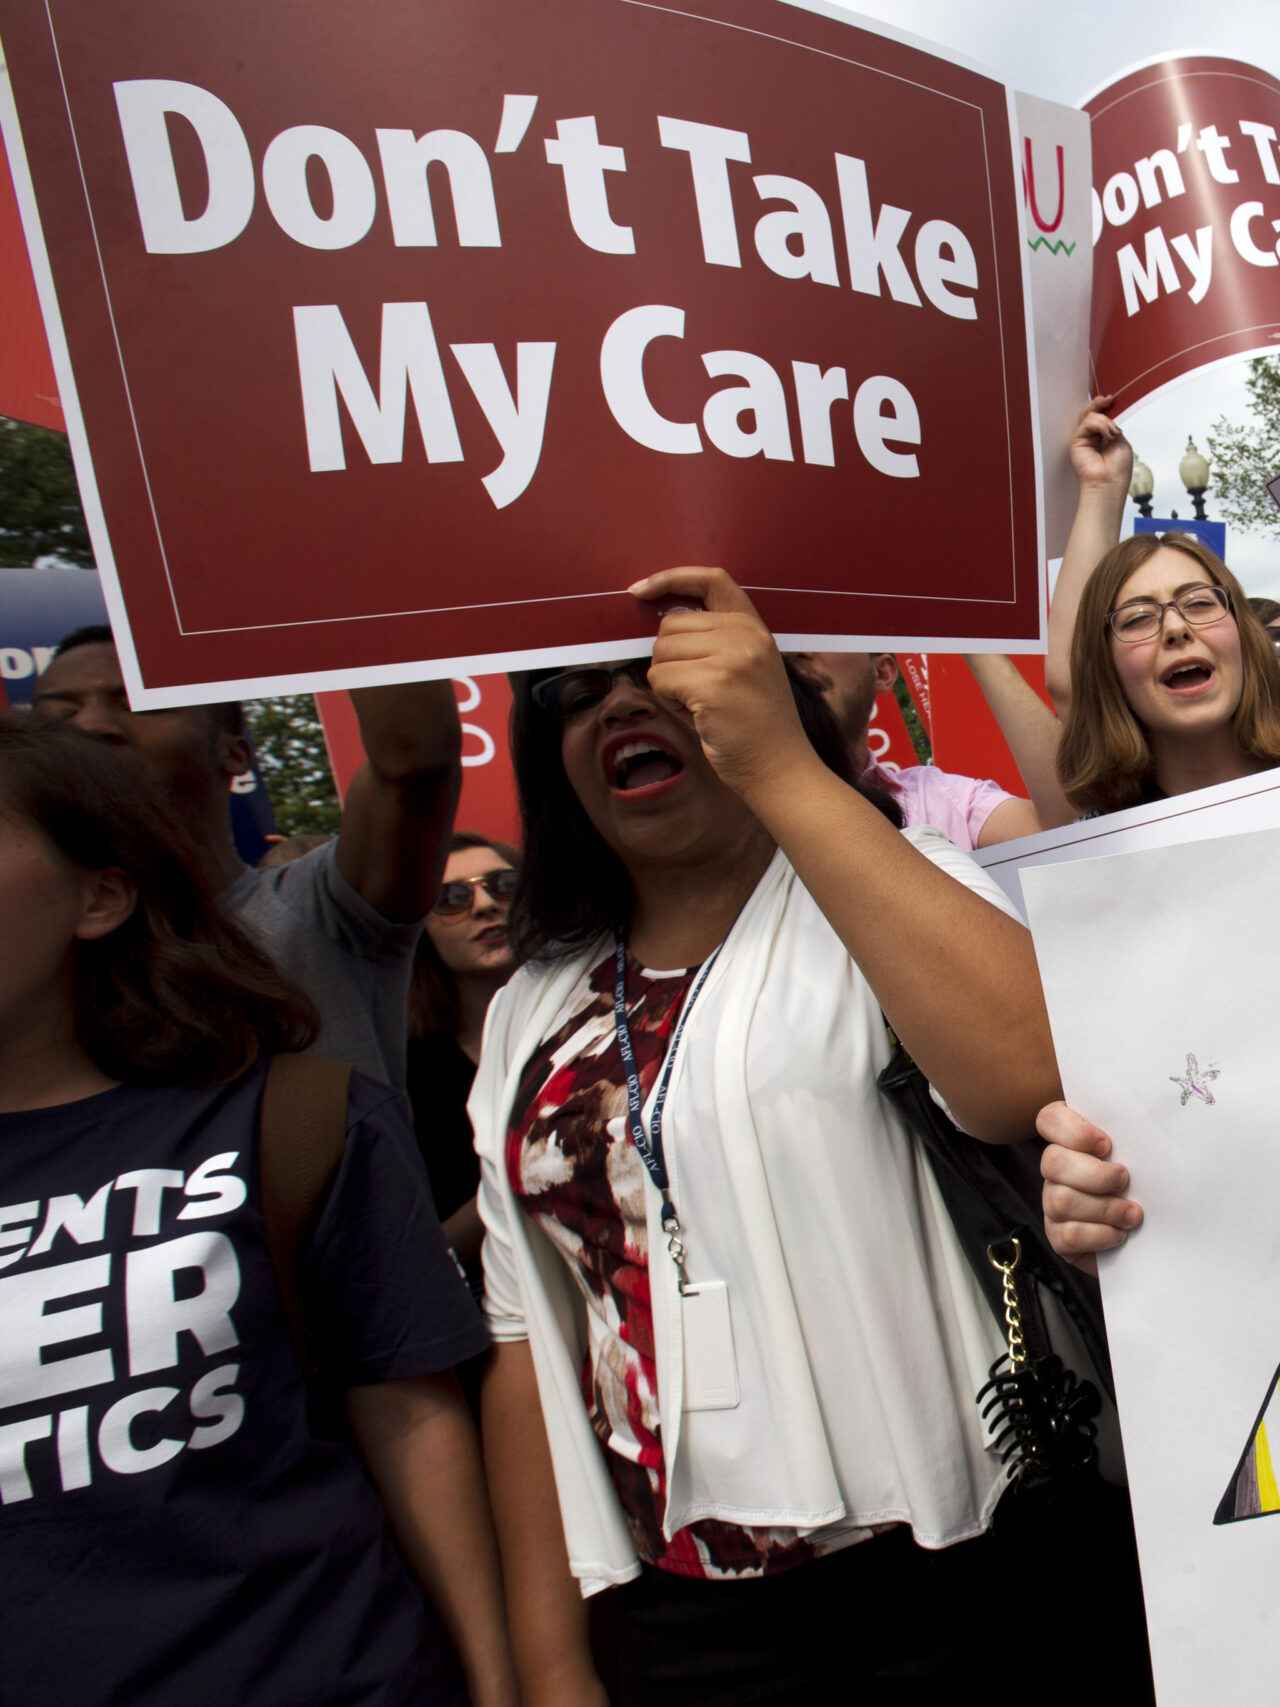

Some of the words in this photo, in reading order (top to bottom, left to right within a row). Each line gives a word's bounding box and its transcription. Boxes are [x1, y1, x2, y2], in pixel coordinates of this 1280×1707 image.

[113, 78, 636, 255] Don't
[657, 115, 979, 321] Take
[1116, 224, 1213, 318] My
[292, 302, 557, 510] My
[600, 304, 922, 479] Care
[905, 658, 923, 693] LOSE
[617, 1024, 634, 1061] AFL-CIO
[627, 1074, 640, 1112] AFL-CIO
[650, 1085, 667, 1134] AFL-CIO
[632, 1125, 660, 1171] AFL-CIO
